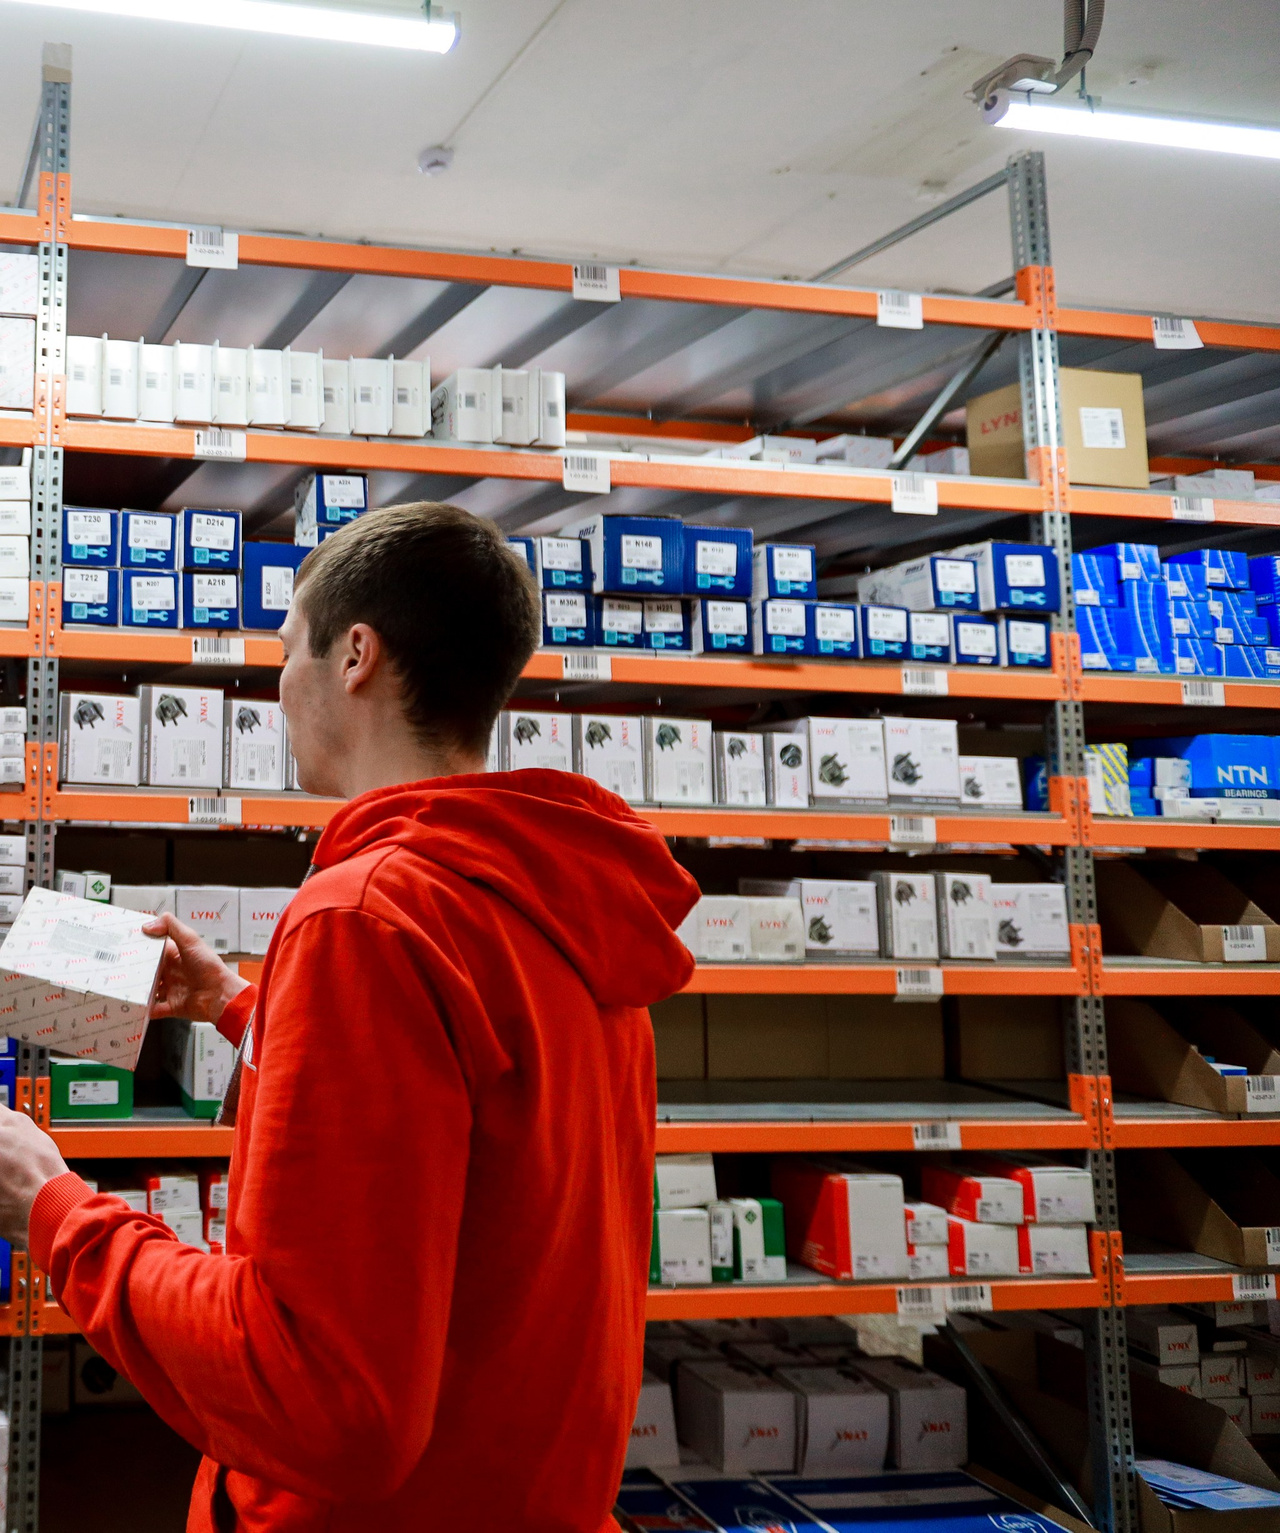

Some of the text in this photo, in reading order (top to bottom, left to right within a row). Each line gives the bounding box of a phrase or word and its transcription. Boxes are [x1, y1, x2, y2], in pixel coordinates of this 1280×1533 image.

[980, 411, 1021, 435] LYN
[83, 514, 102, 524] T230
[205, 518, 225, 528] D214
[79, 573, 99, 582] T212
[207, 578, 226, 587] A218
[559, 599, 578, 607] M304
[116, 700, 125, 728] LYNX
[200, 696, 209, 724] LYNX
[1216, 765, 1268, 786] NTN
[1224, 788, 1268, 799] BEARINGS
[191, 911, 222, 920] LYNX
[706, 918, 735, 928] LYNX
[44, 990, 65, 1002] LYNX
[85, 1012, 110, 1023] LYNX
[36, 1025, 59, 1036] LYNX
[76, 1046, 98, 1057] LYNX
[1167, 1342, 1190, 1351] LYNX
[1209, 1374, 1231, 1384] LYNX
